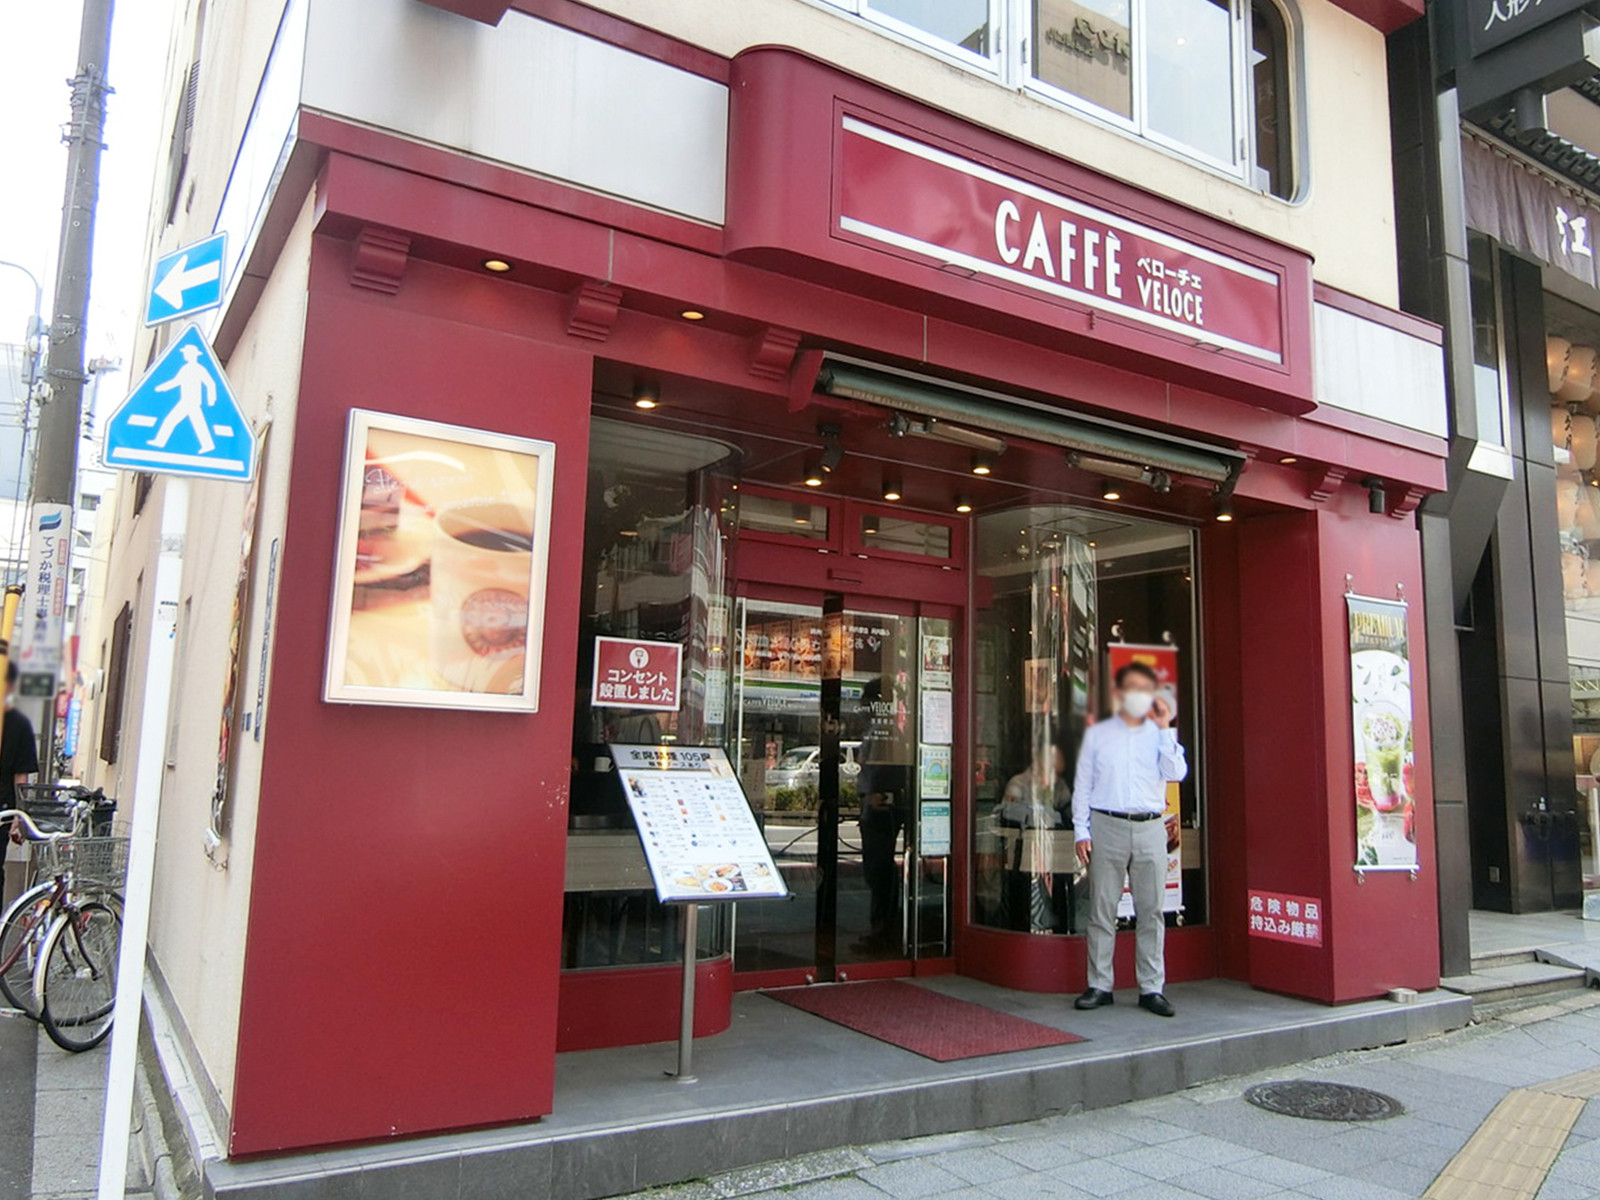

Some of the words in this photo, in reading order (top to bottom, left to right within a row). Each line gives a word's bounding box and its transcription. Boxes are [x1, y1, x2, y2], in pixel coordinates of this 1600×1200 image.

[1484, 0, 1541, 31] 人形
[1556, 206, 1592, 257] 江
[995, 199, 1122, 299] CAFFÈ
[1136, 257, 1202, 290] ベローチェ
[1136, 275, 1203, 325] VELOCE
[599, 683, 674, 701] 設置しました
[607, 669, 668, 686] コンセント
[1250, 896, 1319, 919] 危険物品
[1250, 914, 1320, 939] 持込み厳禁
